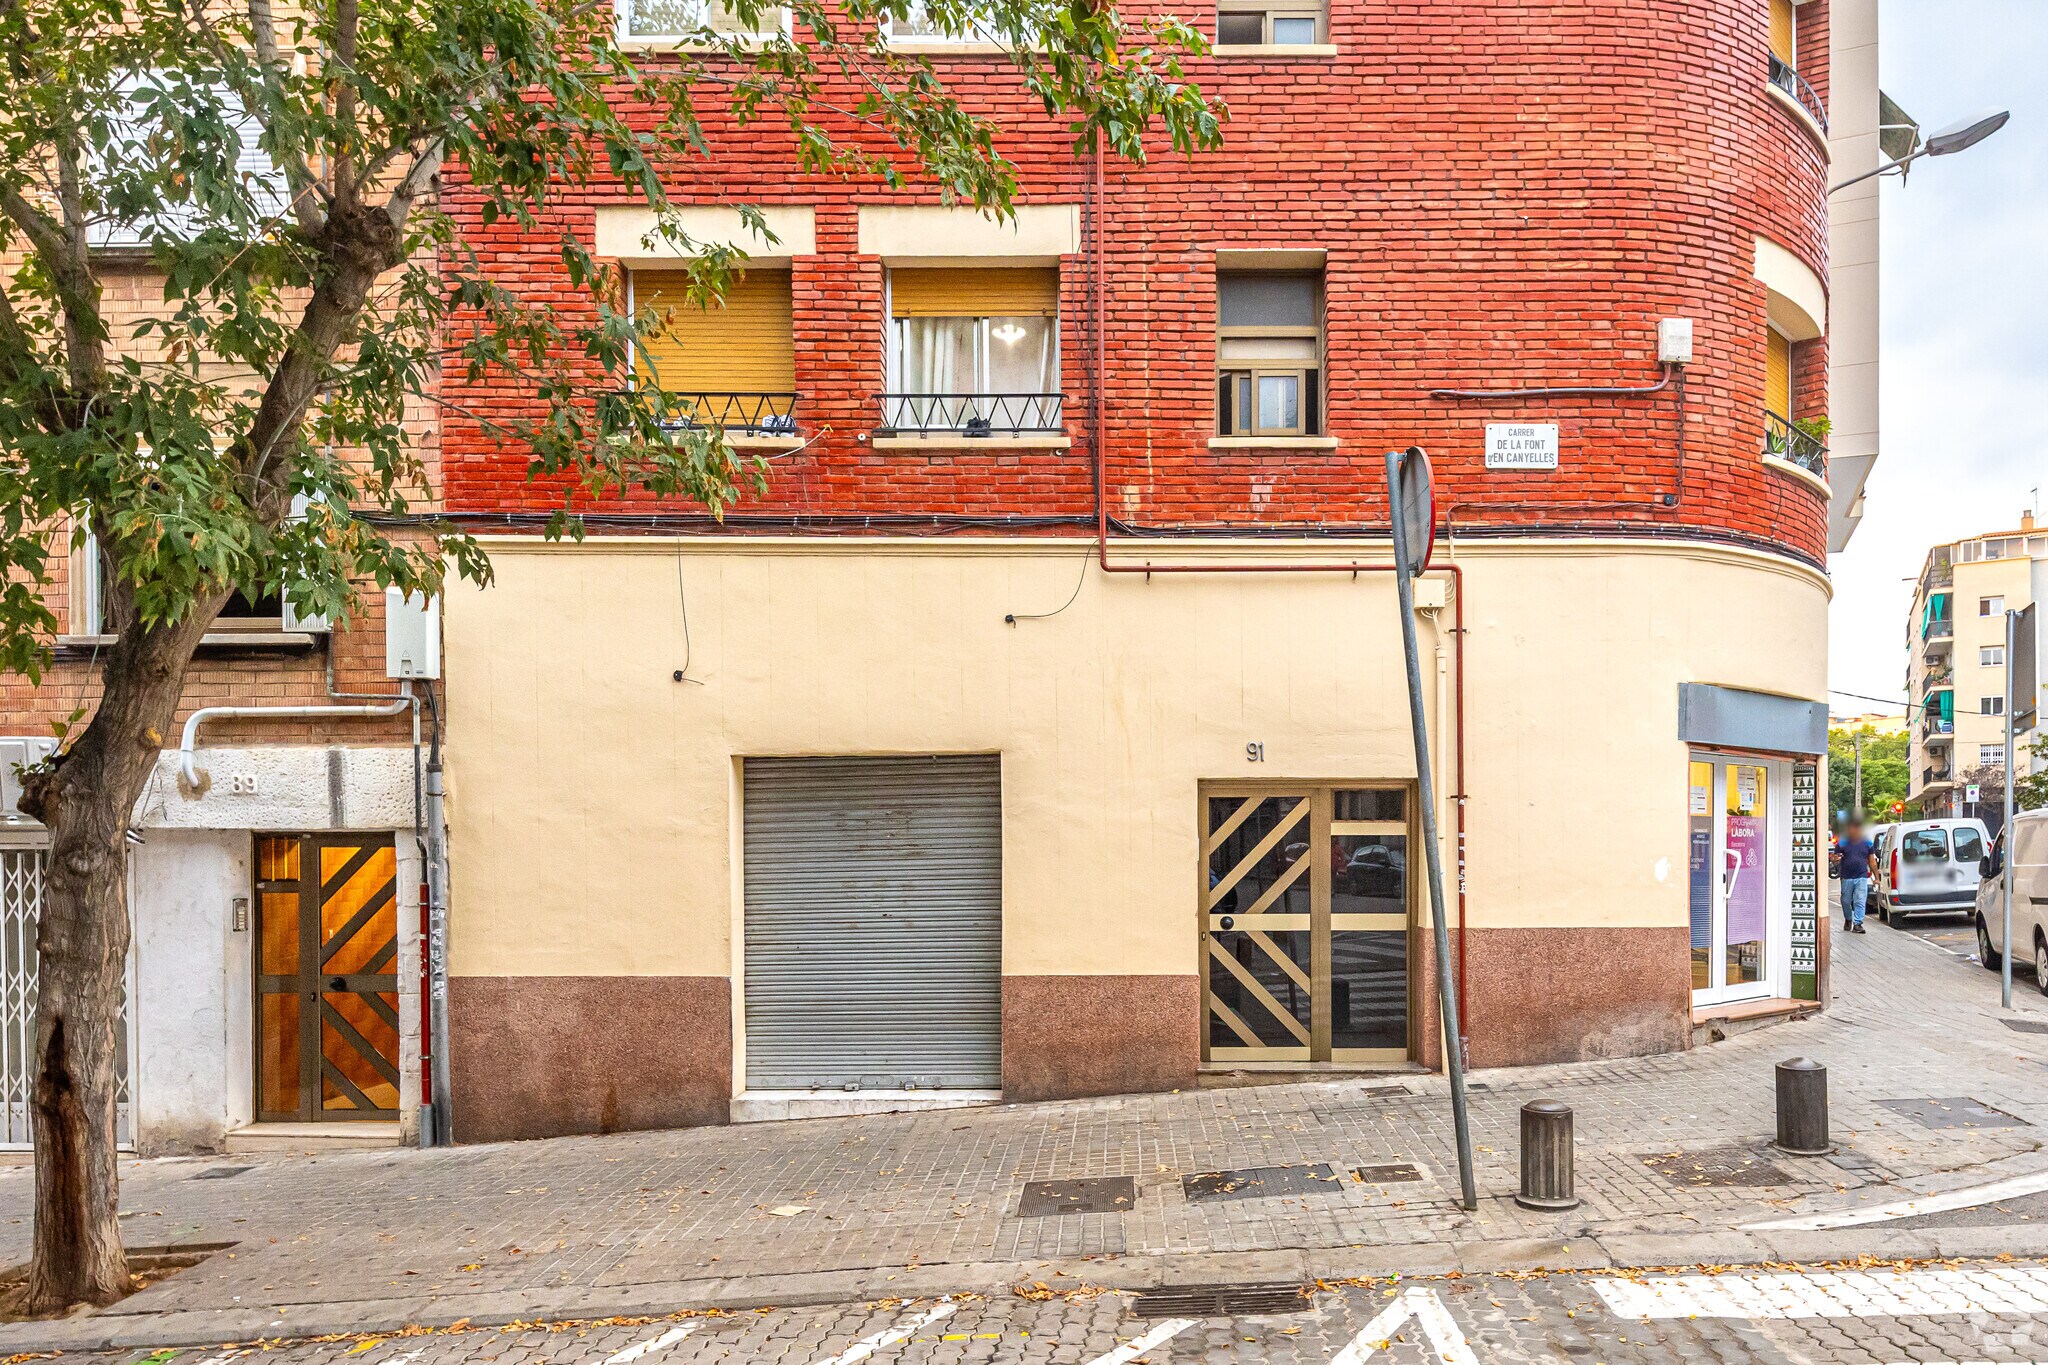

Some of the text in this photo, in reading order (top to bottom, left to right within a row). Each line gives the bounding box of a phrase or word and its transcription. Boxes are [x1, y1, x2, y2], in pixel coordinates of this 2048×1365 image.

[1508, 428, 1535, 437] CARRER
[1497, 439, 1546, 450] DE LA FONT
[1506, 452, 1555, 463] CANYELLES
[1246, 741, 1265, 763] 91
[231, 774, 258, 794] 89
